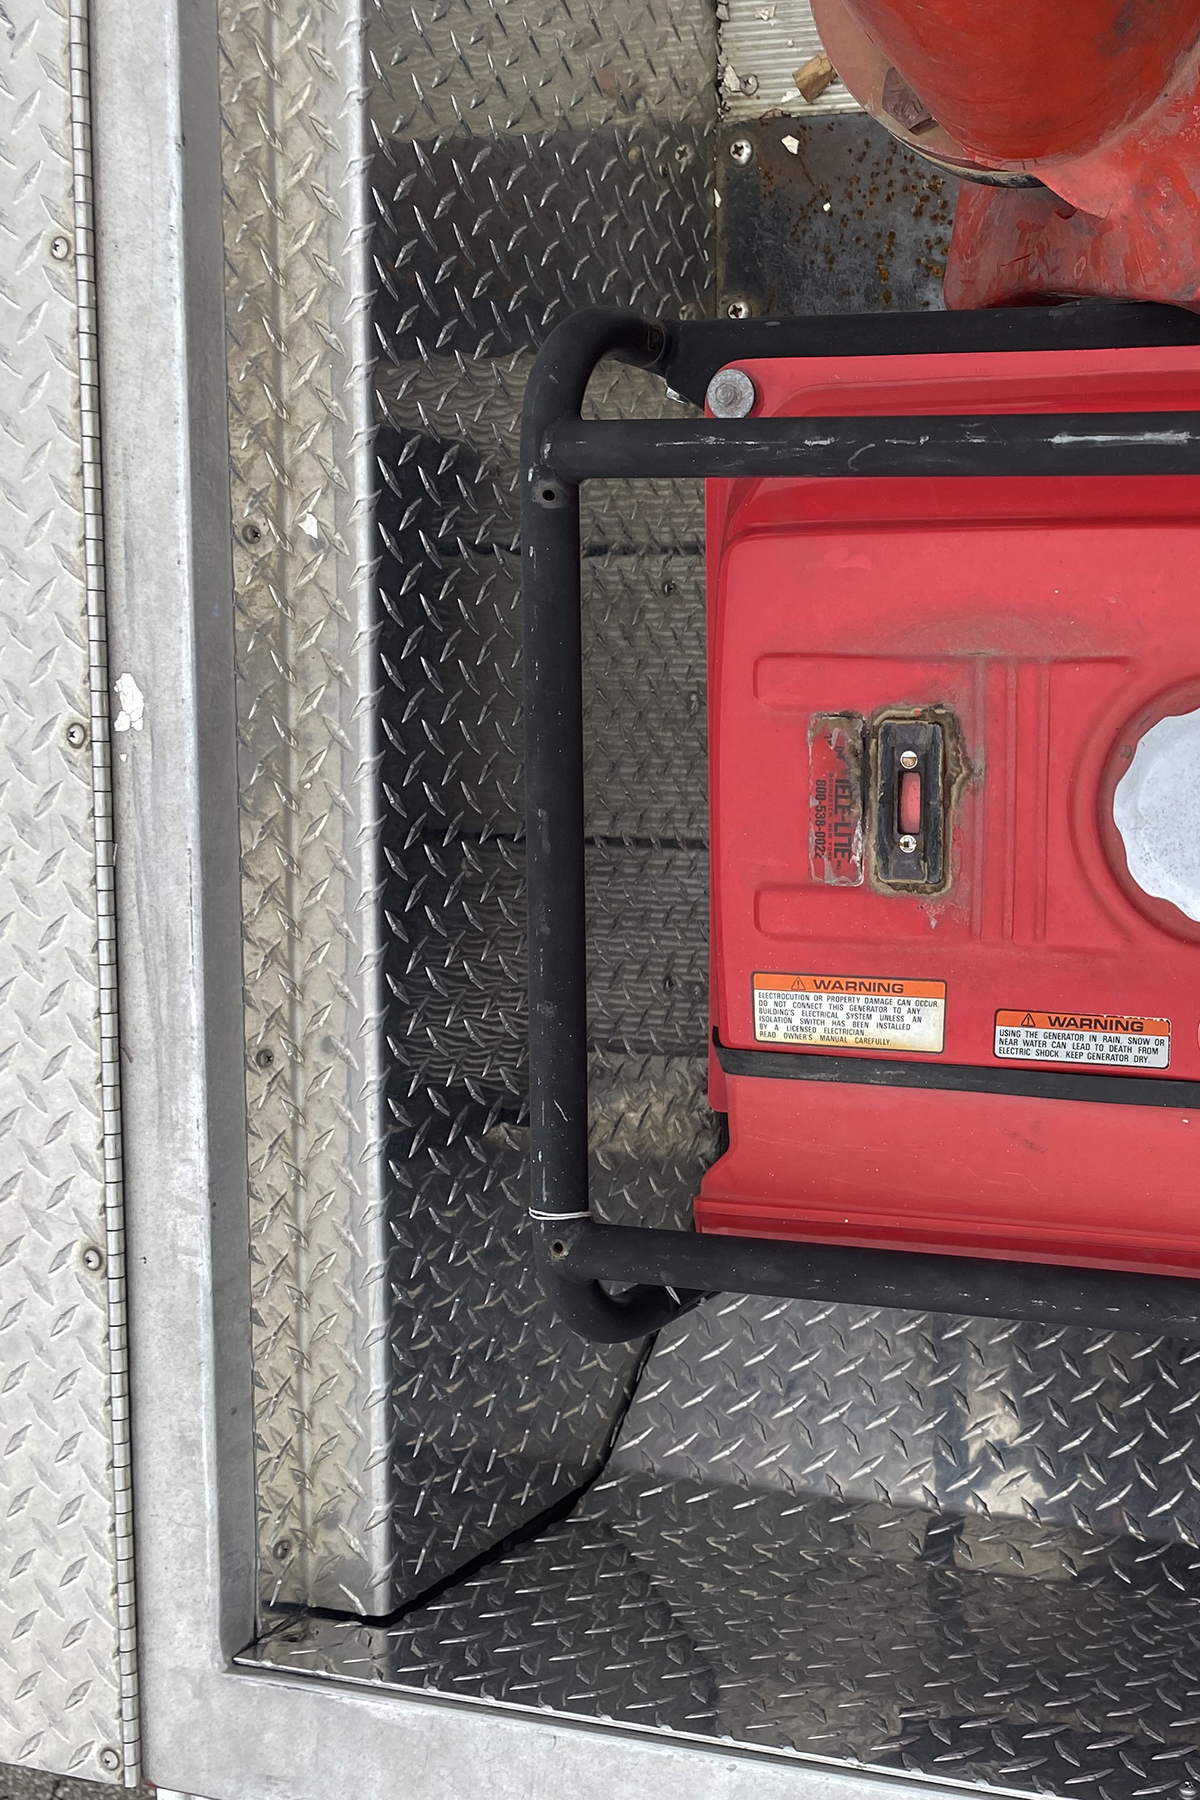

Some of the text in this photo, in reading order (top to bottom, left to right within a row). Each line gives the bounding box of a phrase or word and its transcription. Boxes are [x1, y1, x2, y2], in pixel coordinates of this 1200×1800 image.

[814, 779, 827, 860] 800-538-0022
[813, 980, 904, 993] WARNING
[759, 992, 810, 1001] ELECTROCUTION
[864, 997, 893, 1005] DAMAGE
[759, 1008, 794, 1016] BUILDING'S
[849, 1005, 887, 1013] GENERATOR
[759, 1016, 792, 1024] ISOLATION
[876, 1022, 910, 1030] INSTALLED
[786, 1025, 816, 1033] LICENSED
[1048, 1016, 1144, 1032] WARNING
[820, 1035, 847, 1043] MANUAL
[1000, 1030, 1021, 1038] USING
[1044, 1032, 1084, 1041] GENERATOR
[1089, 1034, 1097, 1042] IN
[1128, 1037, 1150, 1046] SNOW
[999, 1039, 1018, 1047] NEAR
[1023, 1040, 1047, 1048] WATER
[1051, 1041, 1066, 1049] CAN
[1072, 1043, 1090, 1051] LEAD
[1109, 1045, 1132, 1054] DEATH
[1138, 1046, 1158, 1055] FROM
[999, 1047, 1150, 1063] ELECTRIC SHOCK. KEEP GENERATOR DRY.
